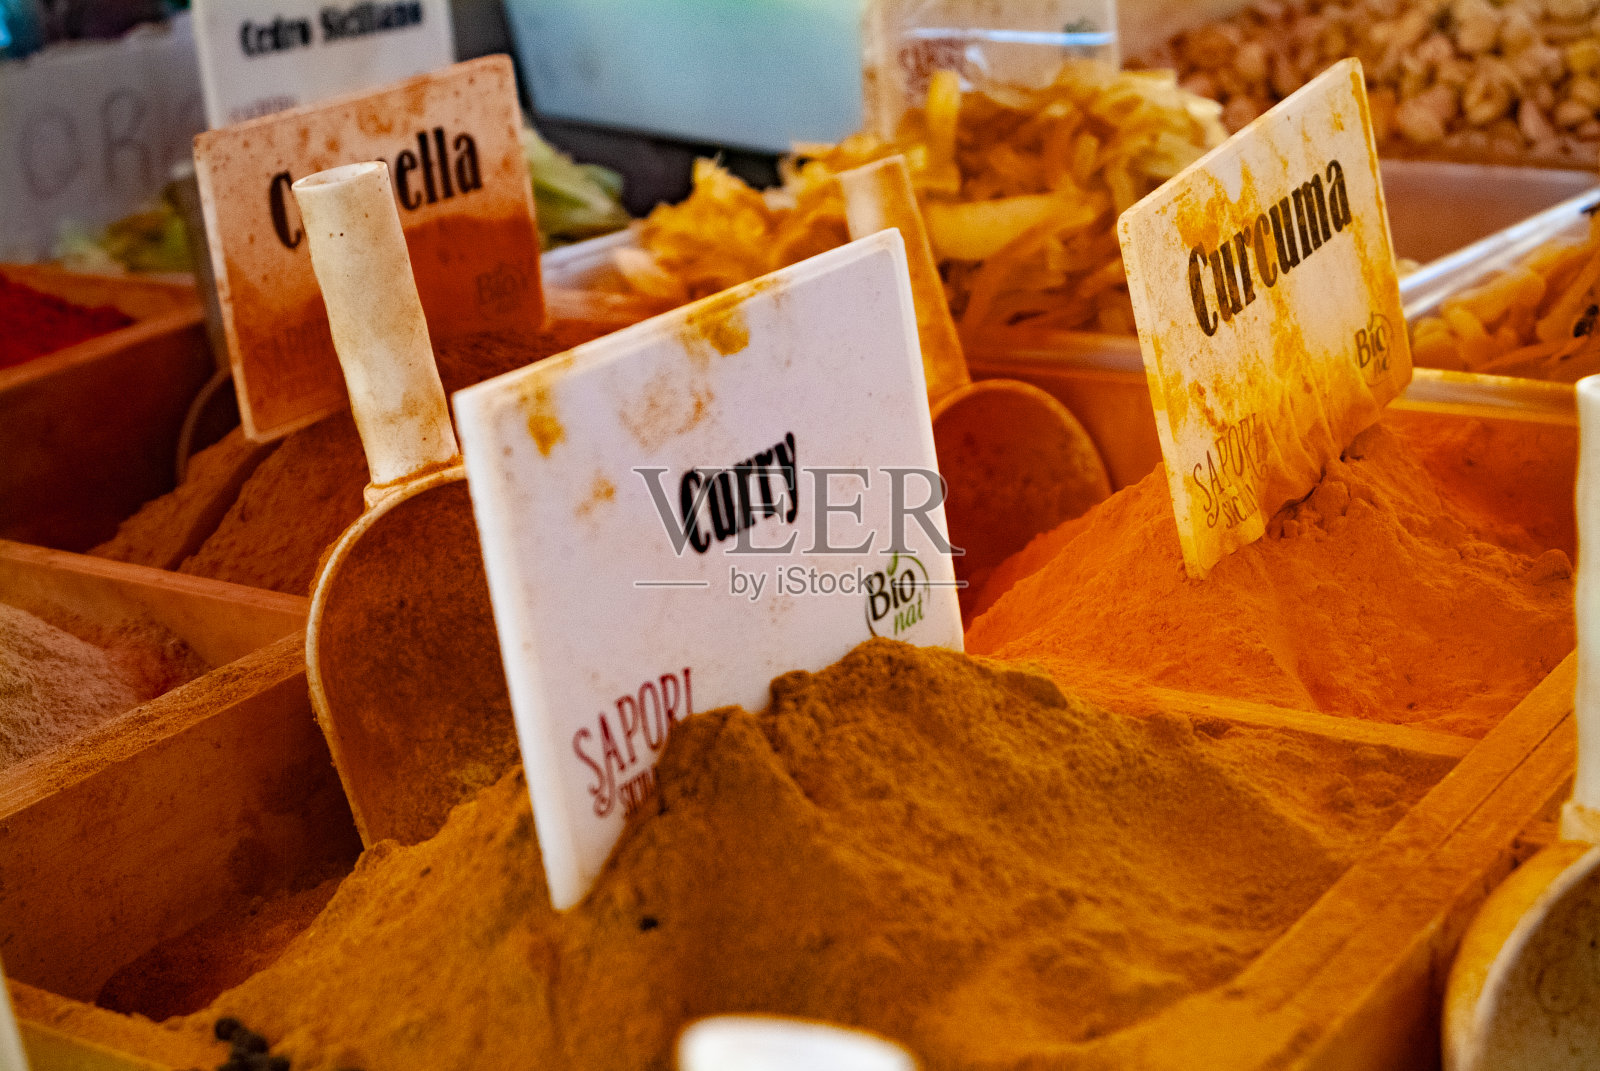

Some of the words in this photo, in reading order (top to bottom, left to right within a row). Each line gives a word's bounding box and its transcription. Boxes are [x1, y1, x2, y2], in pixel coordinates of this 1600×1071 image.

[269, 126, 483, 250] Cella
[1188, 158, 1353, 338] Curcuma
[679, 431, 799, 554] Curry
[866, 562, 916, 622] Bio
